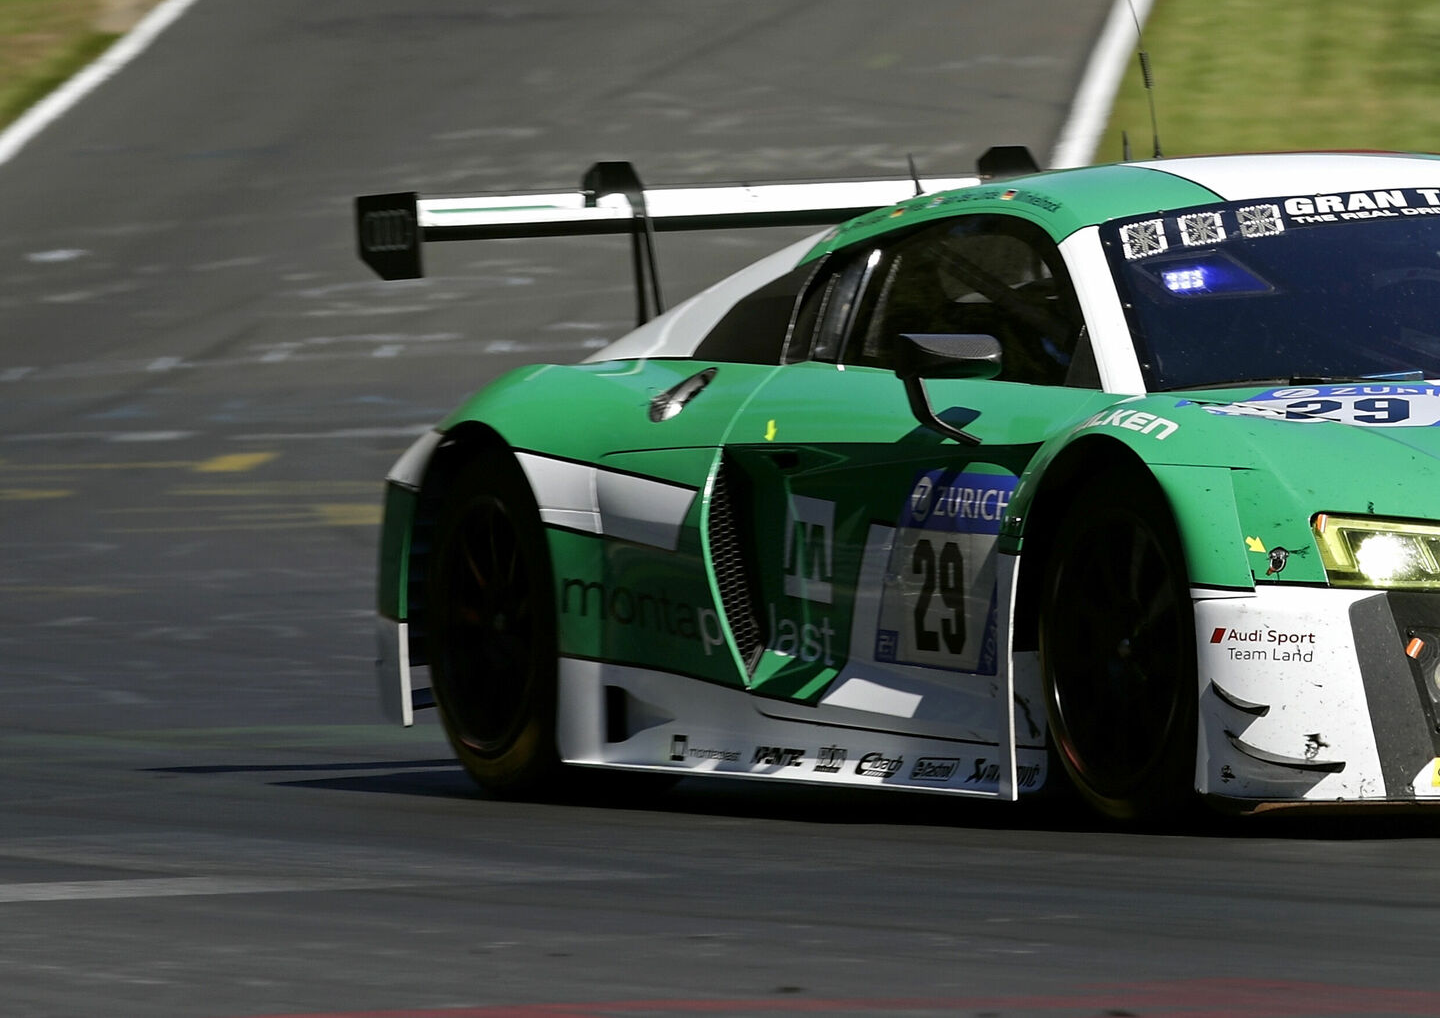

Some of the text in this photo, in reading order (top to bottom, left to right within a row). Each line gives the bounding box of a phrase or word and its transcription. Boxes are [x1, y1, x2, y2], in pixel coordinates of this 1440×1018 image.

[1284, 189, 1408, 216] GRAN
[1291, 214, 1338, 224] THE
[1340, 209, 1399, 221] REAL
[1285, 397, 1410, 423] 29
[913, 538, 967, 655] 29
[1227, 628, 1316, 646] Audi Sport
[1227, 647, 1314, 663] Team Land
